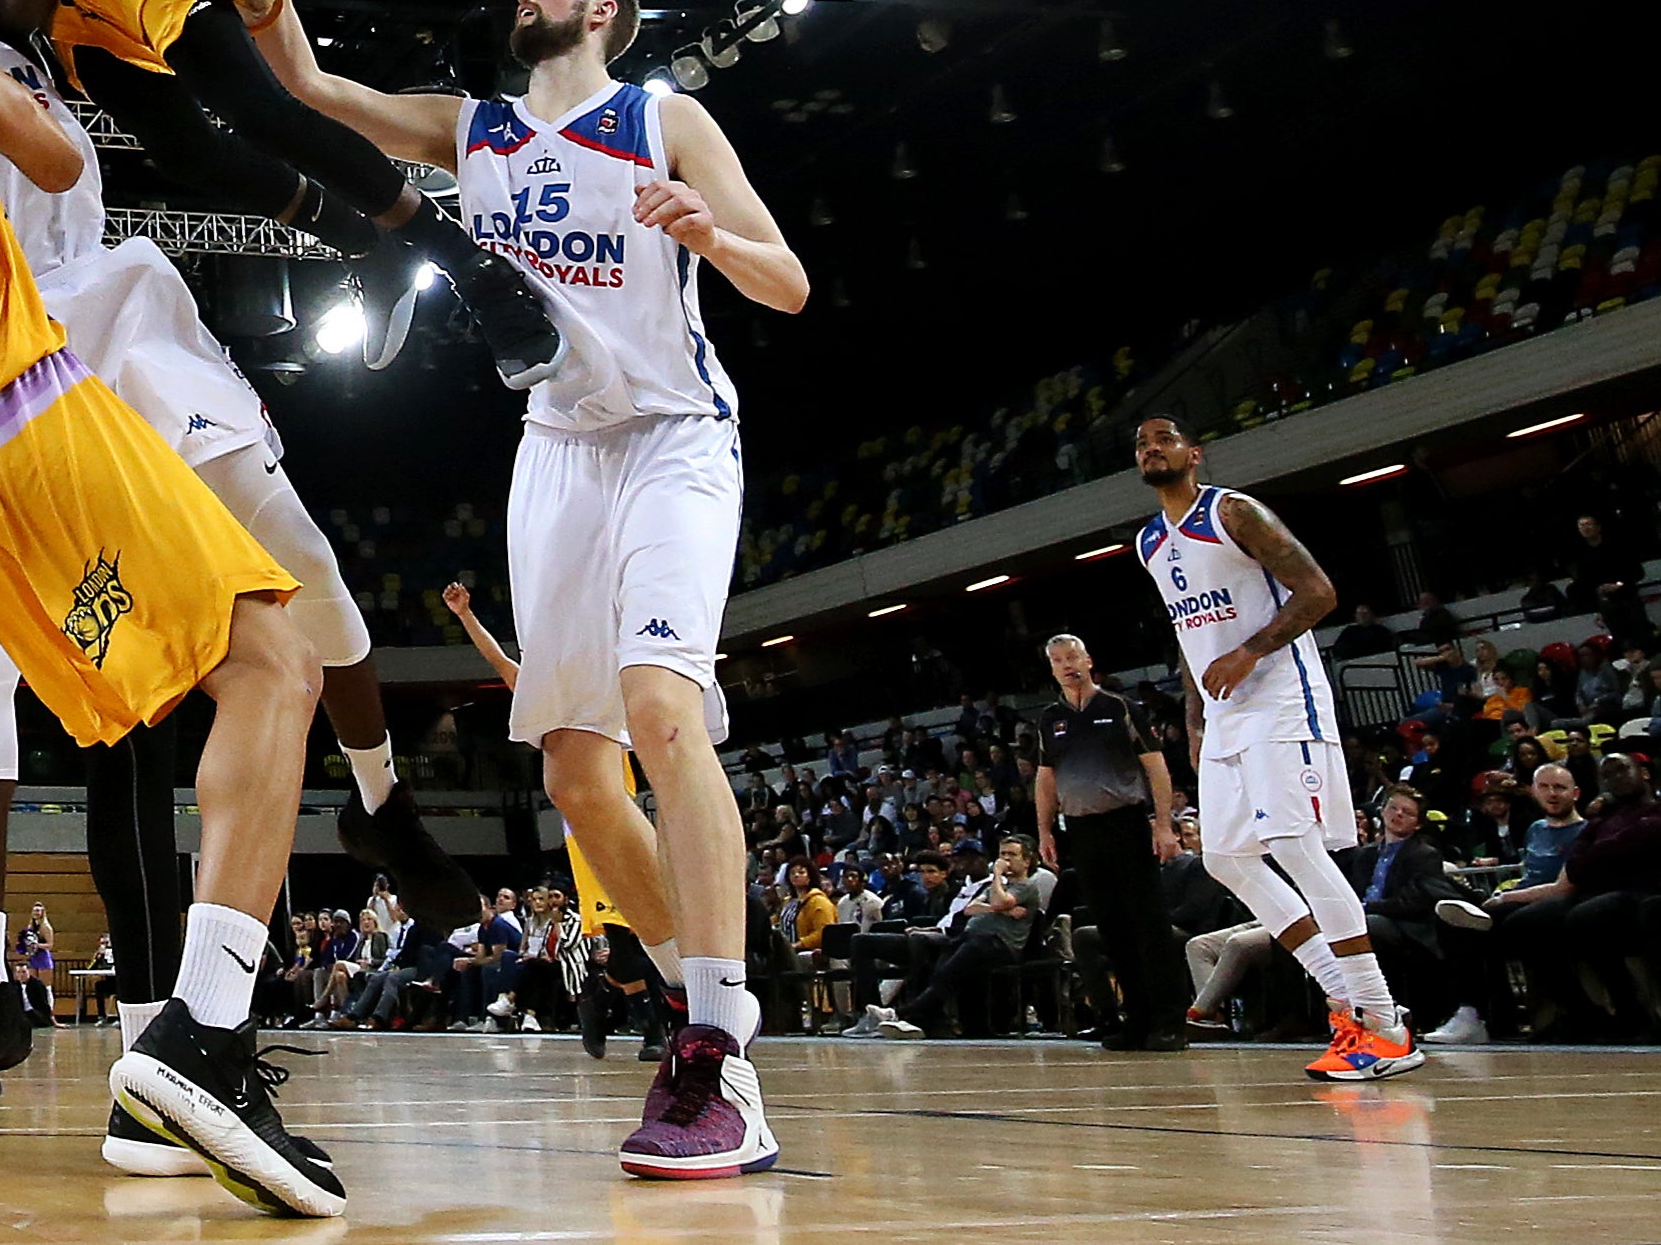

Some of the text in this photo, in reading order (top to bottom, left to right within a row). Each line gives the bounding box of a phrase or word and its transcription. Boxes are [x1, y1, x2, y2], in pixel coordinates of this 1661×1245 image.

[510, 183, 571, 222] 15
[74, 561, 114, 604] LONDON
[1171, 565, 1188, 592] 6
[1167, 587, 1233, 622] ONDON
[1185, 606, 1238, 630] ROYALS
